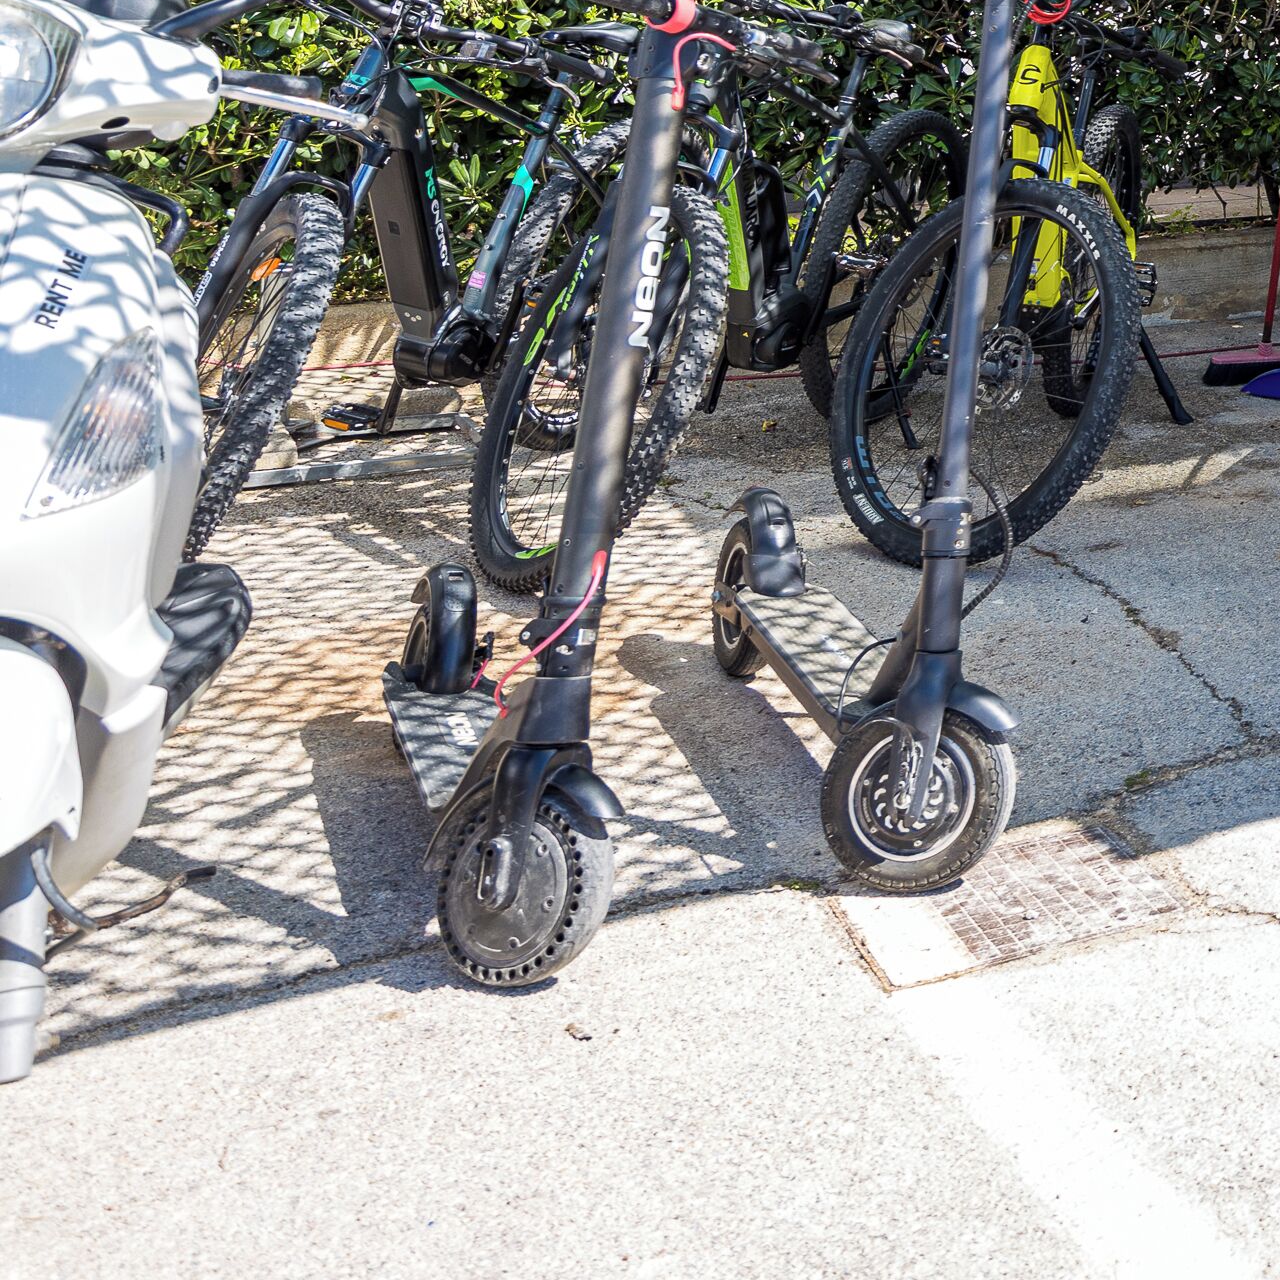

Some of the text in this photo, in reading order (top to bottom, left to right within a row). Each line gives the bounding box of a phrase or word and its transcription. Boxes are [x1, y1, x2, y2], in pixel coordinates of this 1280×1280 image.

[1056, 204, 1100, 261] MAXXIS
[34, 248, 88, 330] RENT ME
[853, 493, 885, 526] ARDENT
